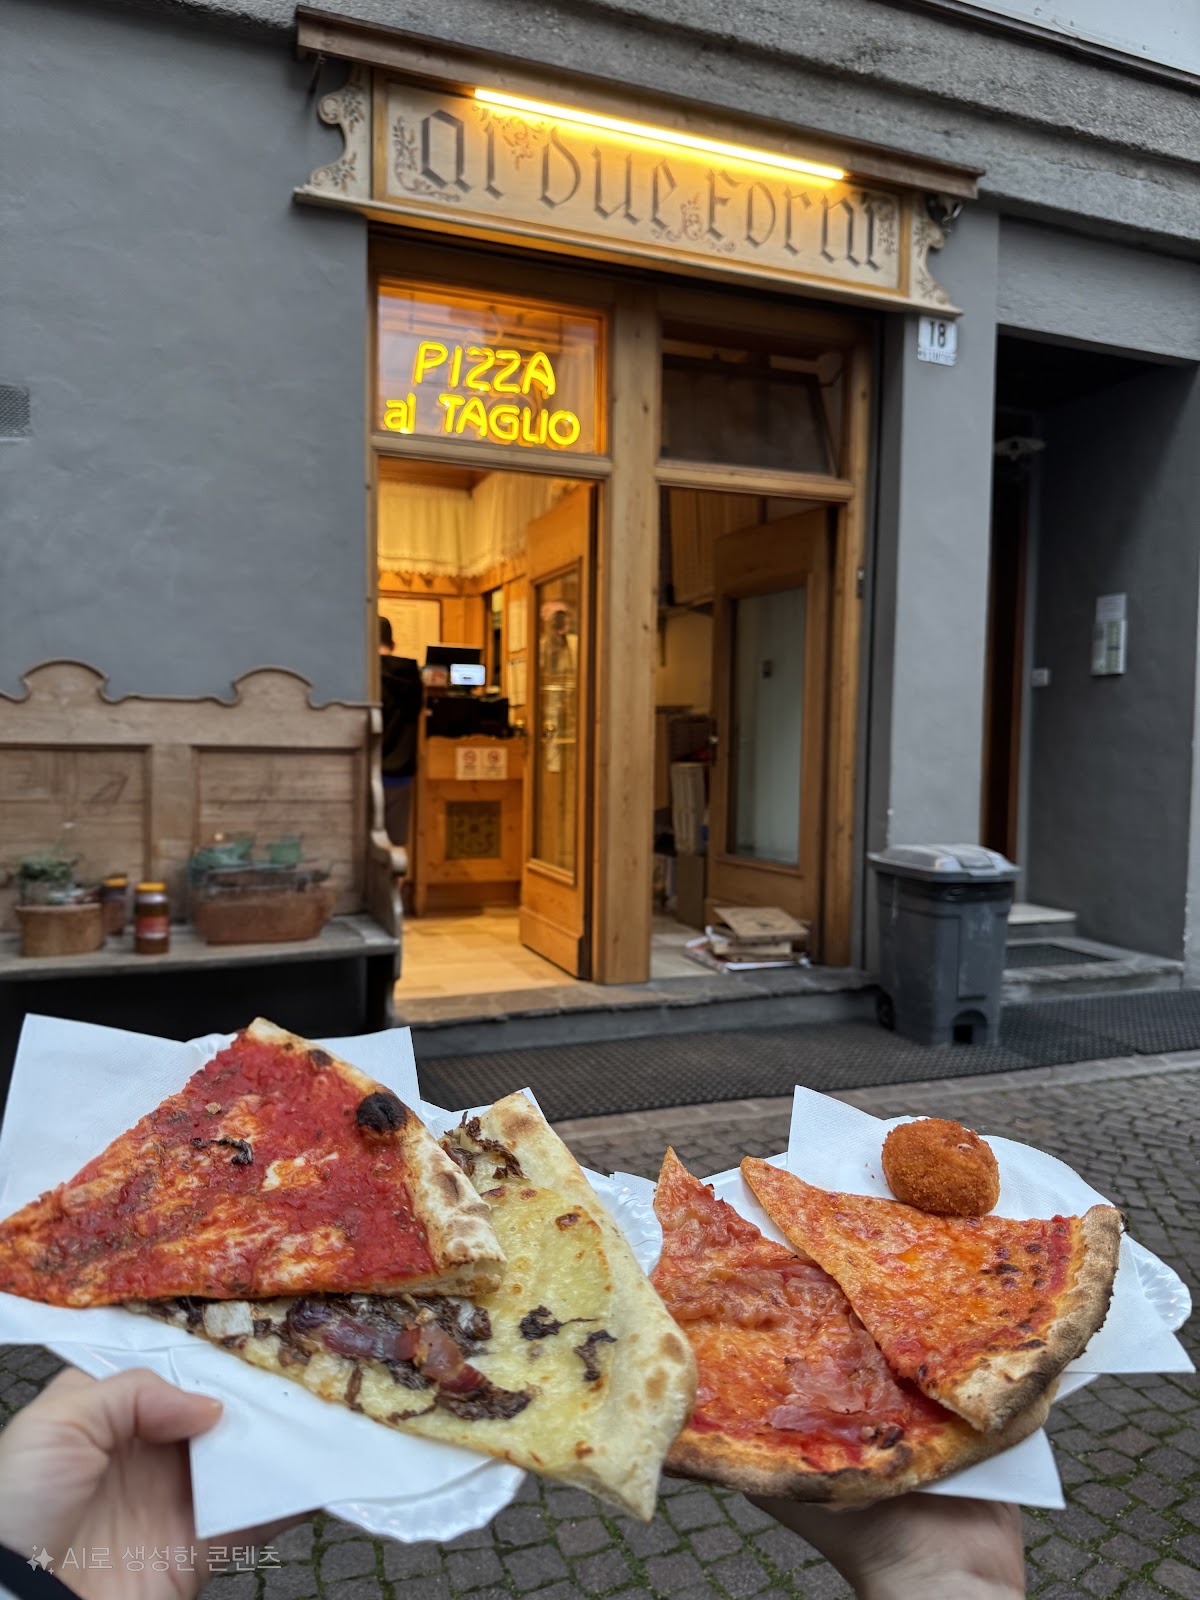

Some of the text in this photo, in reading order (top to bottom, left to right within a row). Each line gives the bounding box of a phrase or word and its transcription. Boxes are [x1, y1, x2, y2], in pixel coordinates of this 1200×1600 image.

[930, 320, 946, 348] 18
[413, 340, 556, 395] PIZZA
[383, 392, 581, 446] al TAGLIO
